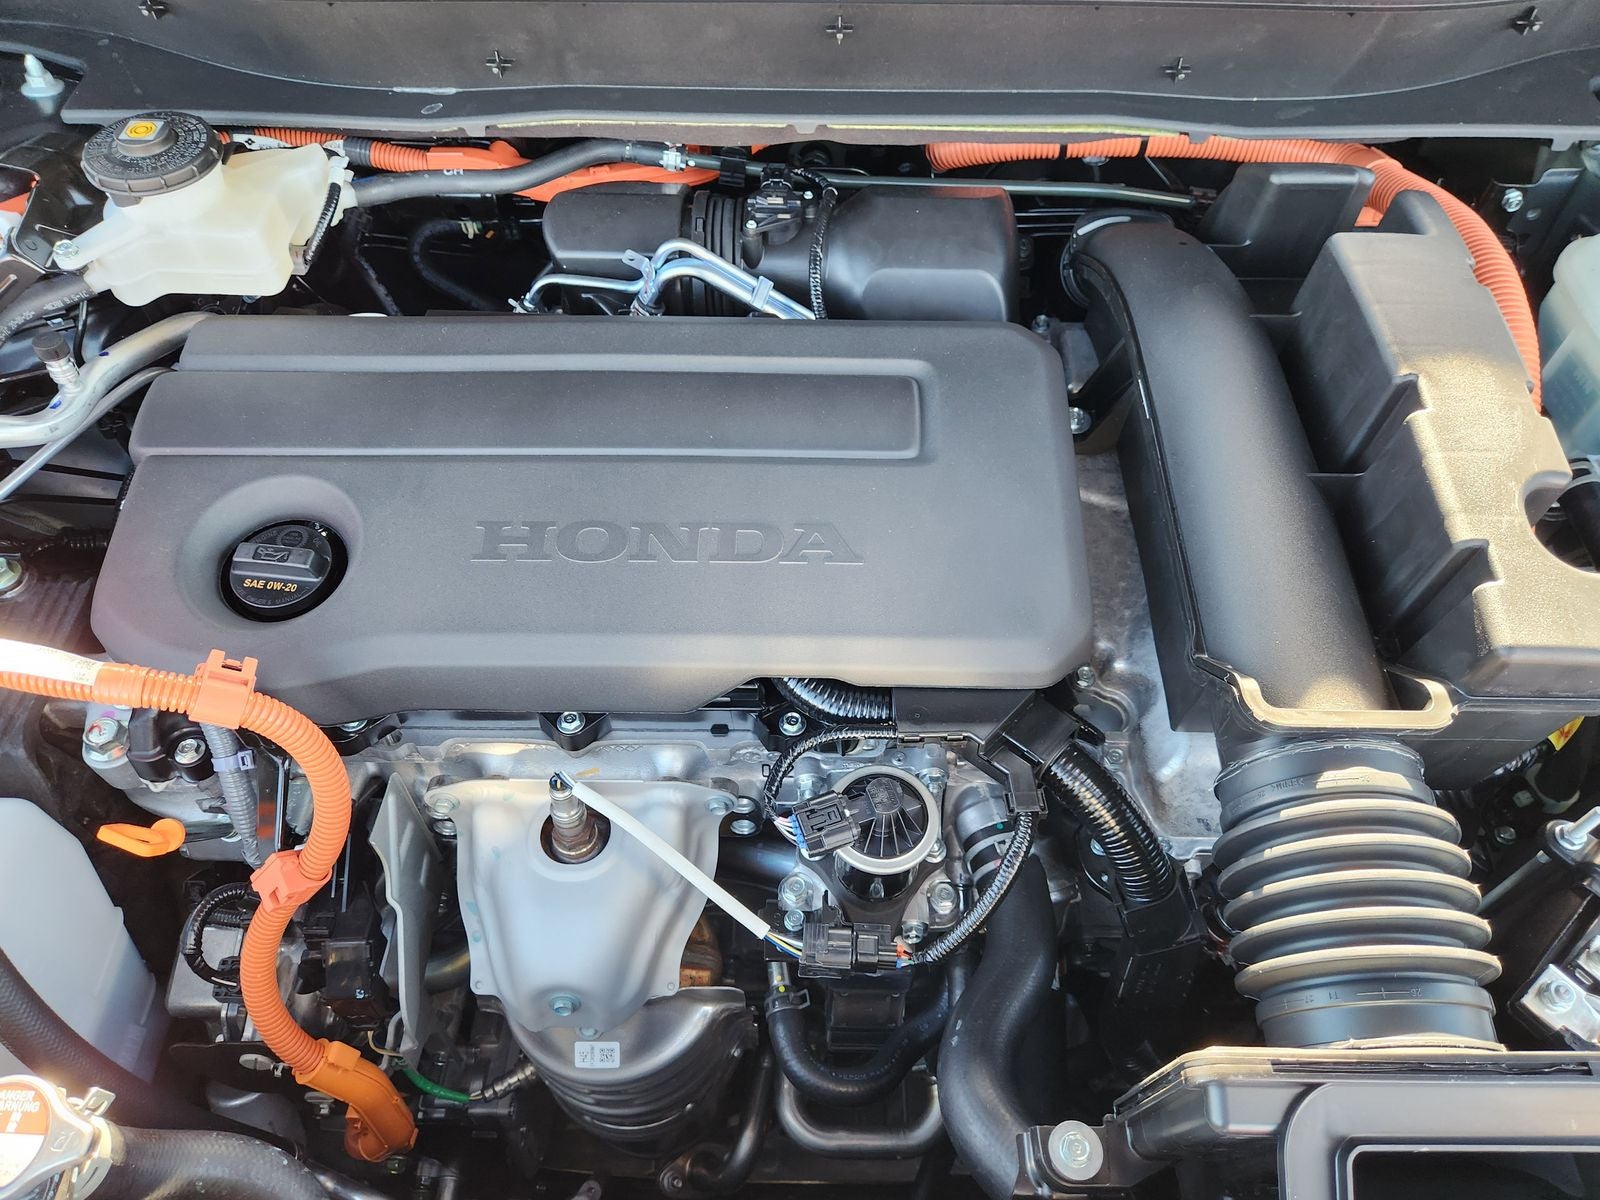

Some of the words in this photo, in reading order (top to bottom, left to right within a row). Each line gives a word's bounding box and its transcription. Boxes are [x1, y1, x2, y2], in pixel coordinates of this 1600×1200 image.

[470, 520, 865, 565] HONDA
[243, 578, 266, 590] SAE
[266, 581, 298, 593] 0W-20
[0, 1090, 36, 1101] ANGER
[0, 1100, 40, 1113] ARNUNG
